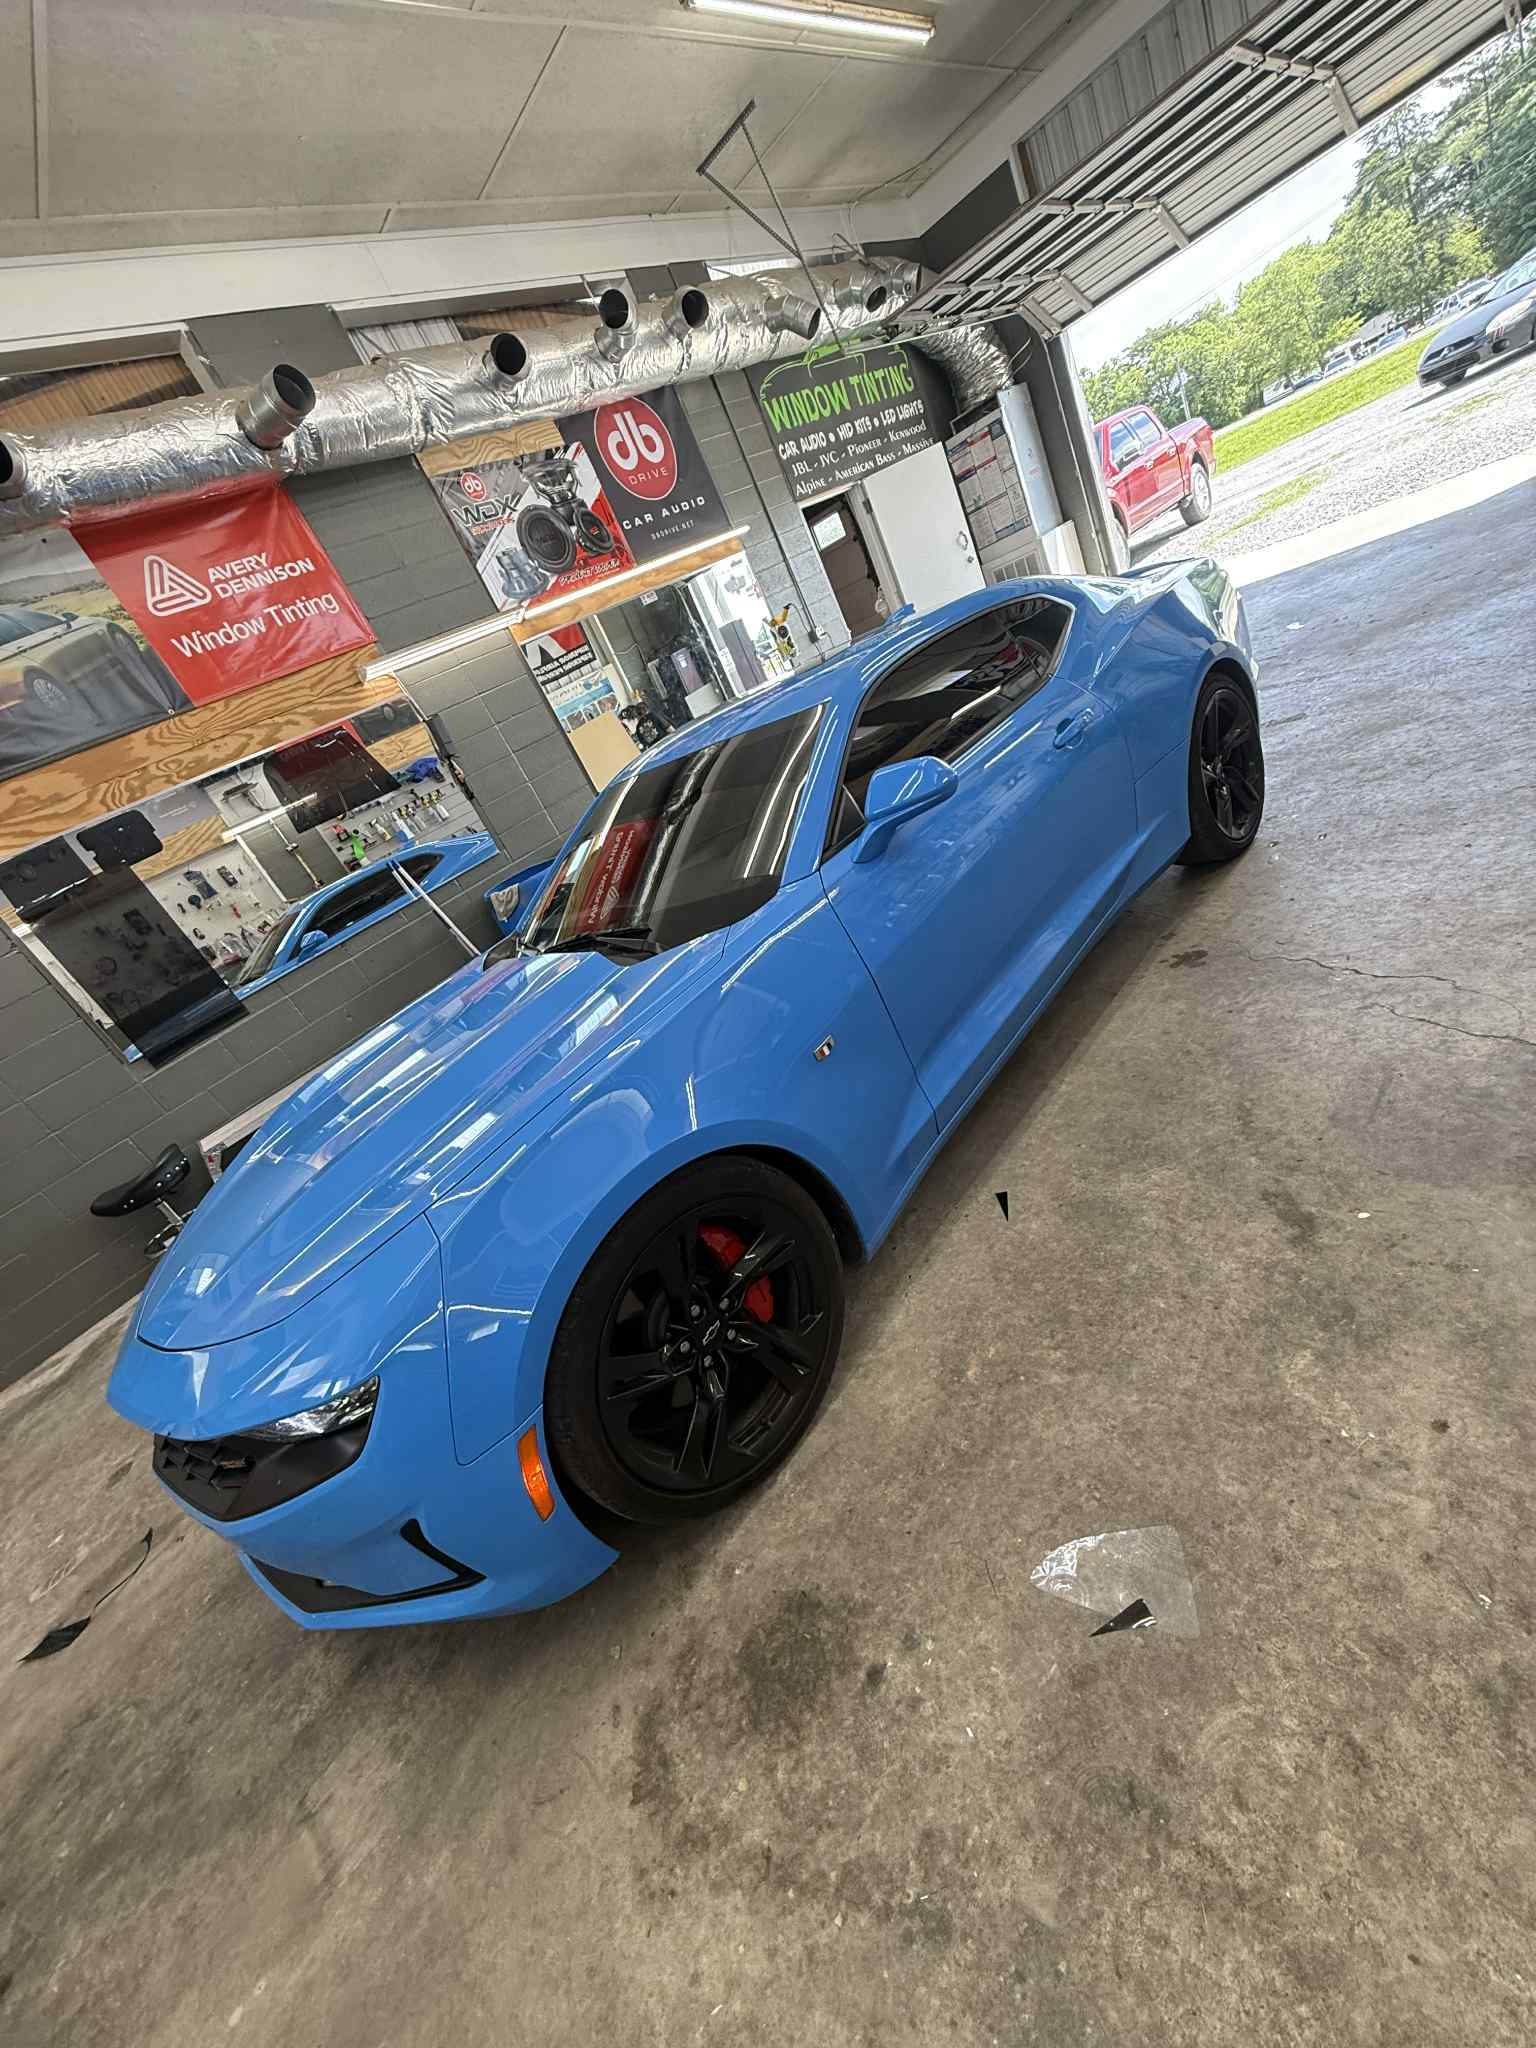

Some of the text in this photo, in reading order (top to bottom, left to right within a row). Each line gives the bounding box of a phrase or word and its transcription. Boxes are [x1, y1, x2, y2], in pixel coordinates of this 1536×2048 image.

[764, 363, 914, 433] WINDOW TINTING
[607, 410, 665, 470] db
[778, 400, 925, 460] CAR AUDIO HID KITS LED LIGHTS
[628, 467, 669, 485] DRIVE
[791, 460, 813, 477] JBL
[819, 451, 839, 468] JVC
[450, 493, 521, 527] WDX
[622, 496, 705, 530] CAR AUDIO
[207, 552, 269, 583] AVERY
[214, 557, 316, 599] DENNISON
[170, 593, 340, 657] Window Tinting
